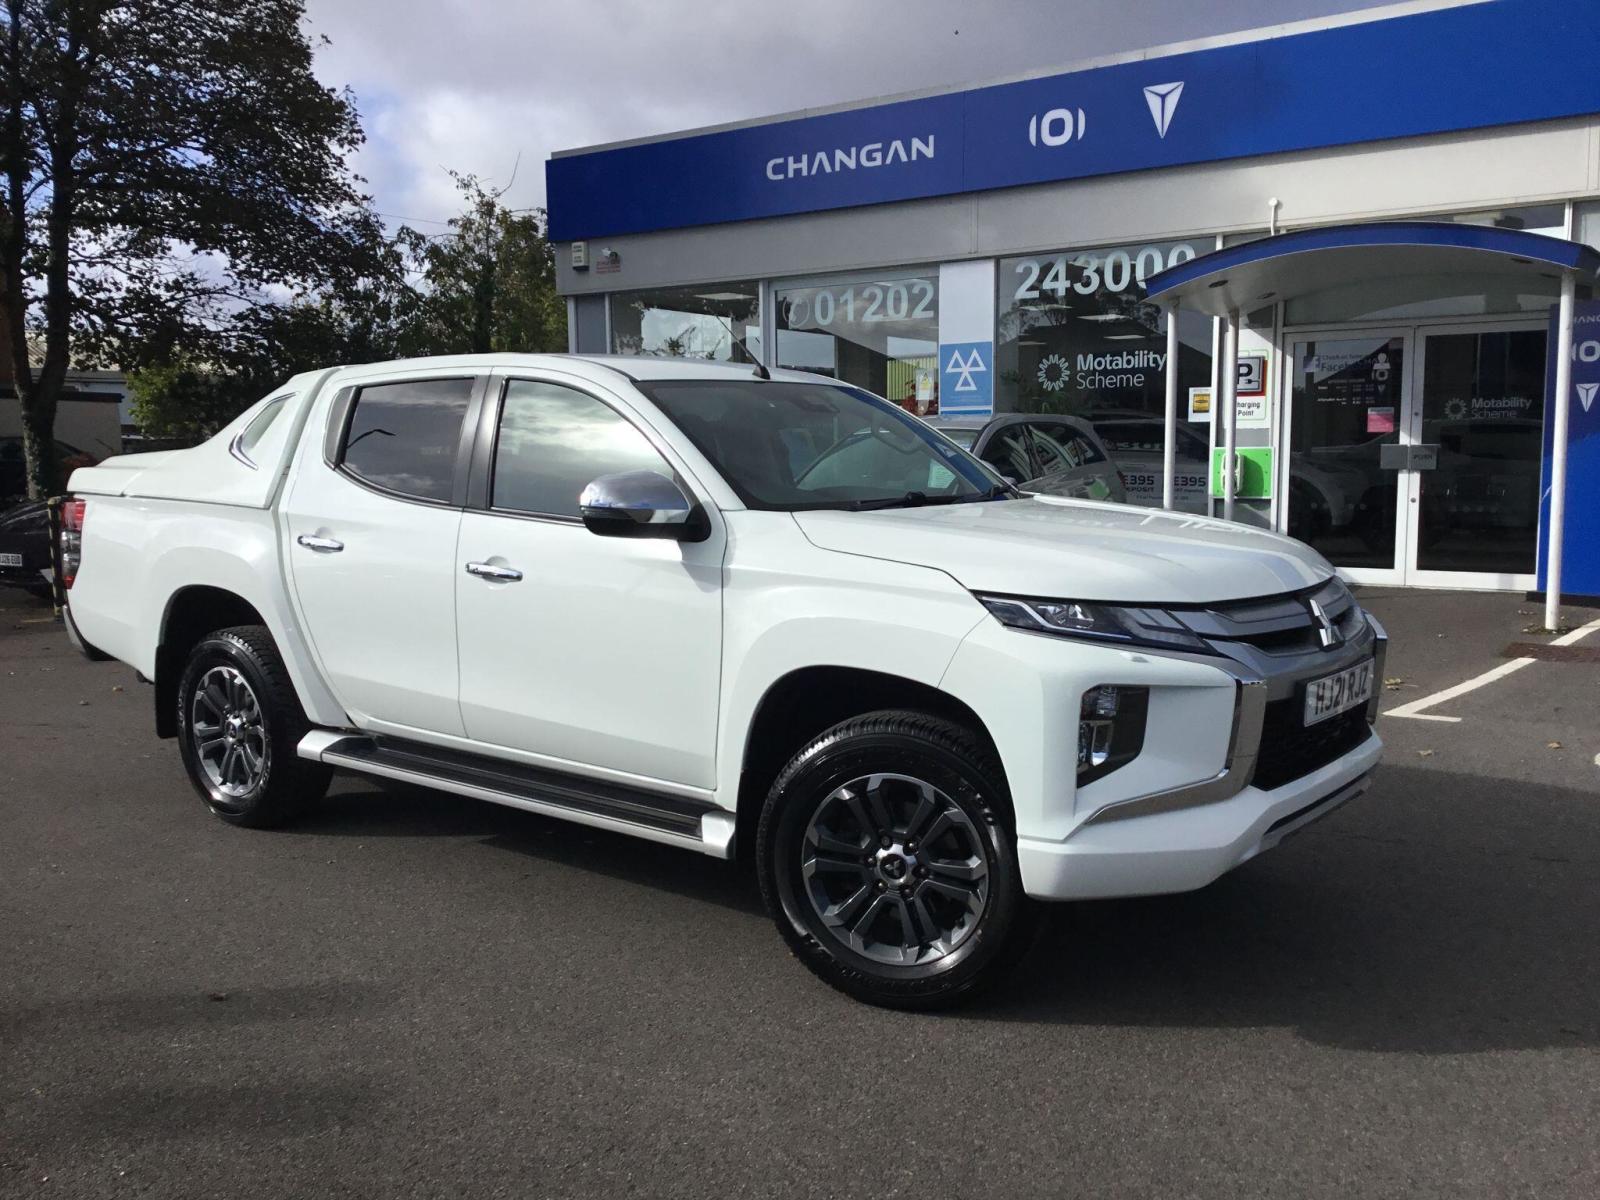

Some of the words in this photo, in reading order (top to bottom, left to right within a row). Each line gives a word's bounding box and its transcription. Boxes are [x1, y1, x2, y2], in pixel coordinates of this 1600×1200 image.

[766, 135, 935, 181] CHANGAN
[814, 279, 935, 326] 01202
[1076, 350, 1168, 372] Motability
[1076, 371, 1145, 389] Scheme
[1471, 397, 1532, 409] Motability
[1471, 408, 1518, 419] Scheme
[1315, 676, 1346, 715] HJ21
[1347, 664, 1369, 703] RJZ
